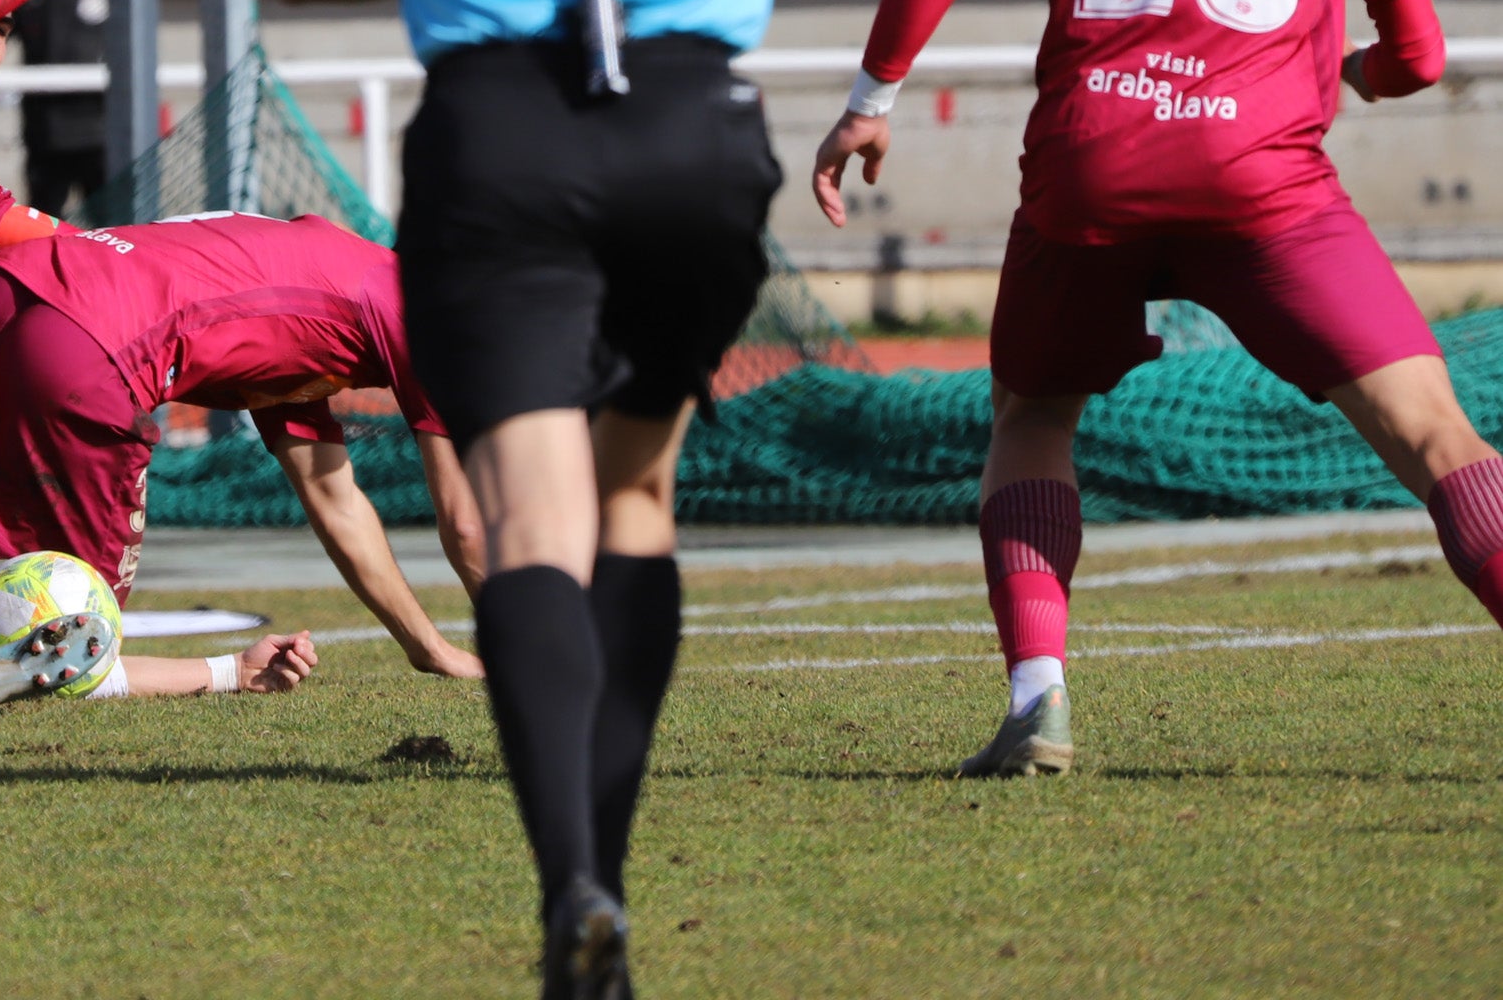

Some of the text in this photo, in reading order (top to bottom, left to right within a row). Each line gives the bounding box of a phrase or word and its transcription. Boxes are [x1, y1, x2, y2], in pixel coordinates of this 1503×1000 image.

[1146, 51, 1206, 78] visit
[1087, 68, 1173, 101] araba
[1154, 91, 1238, 121] alava
